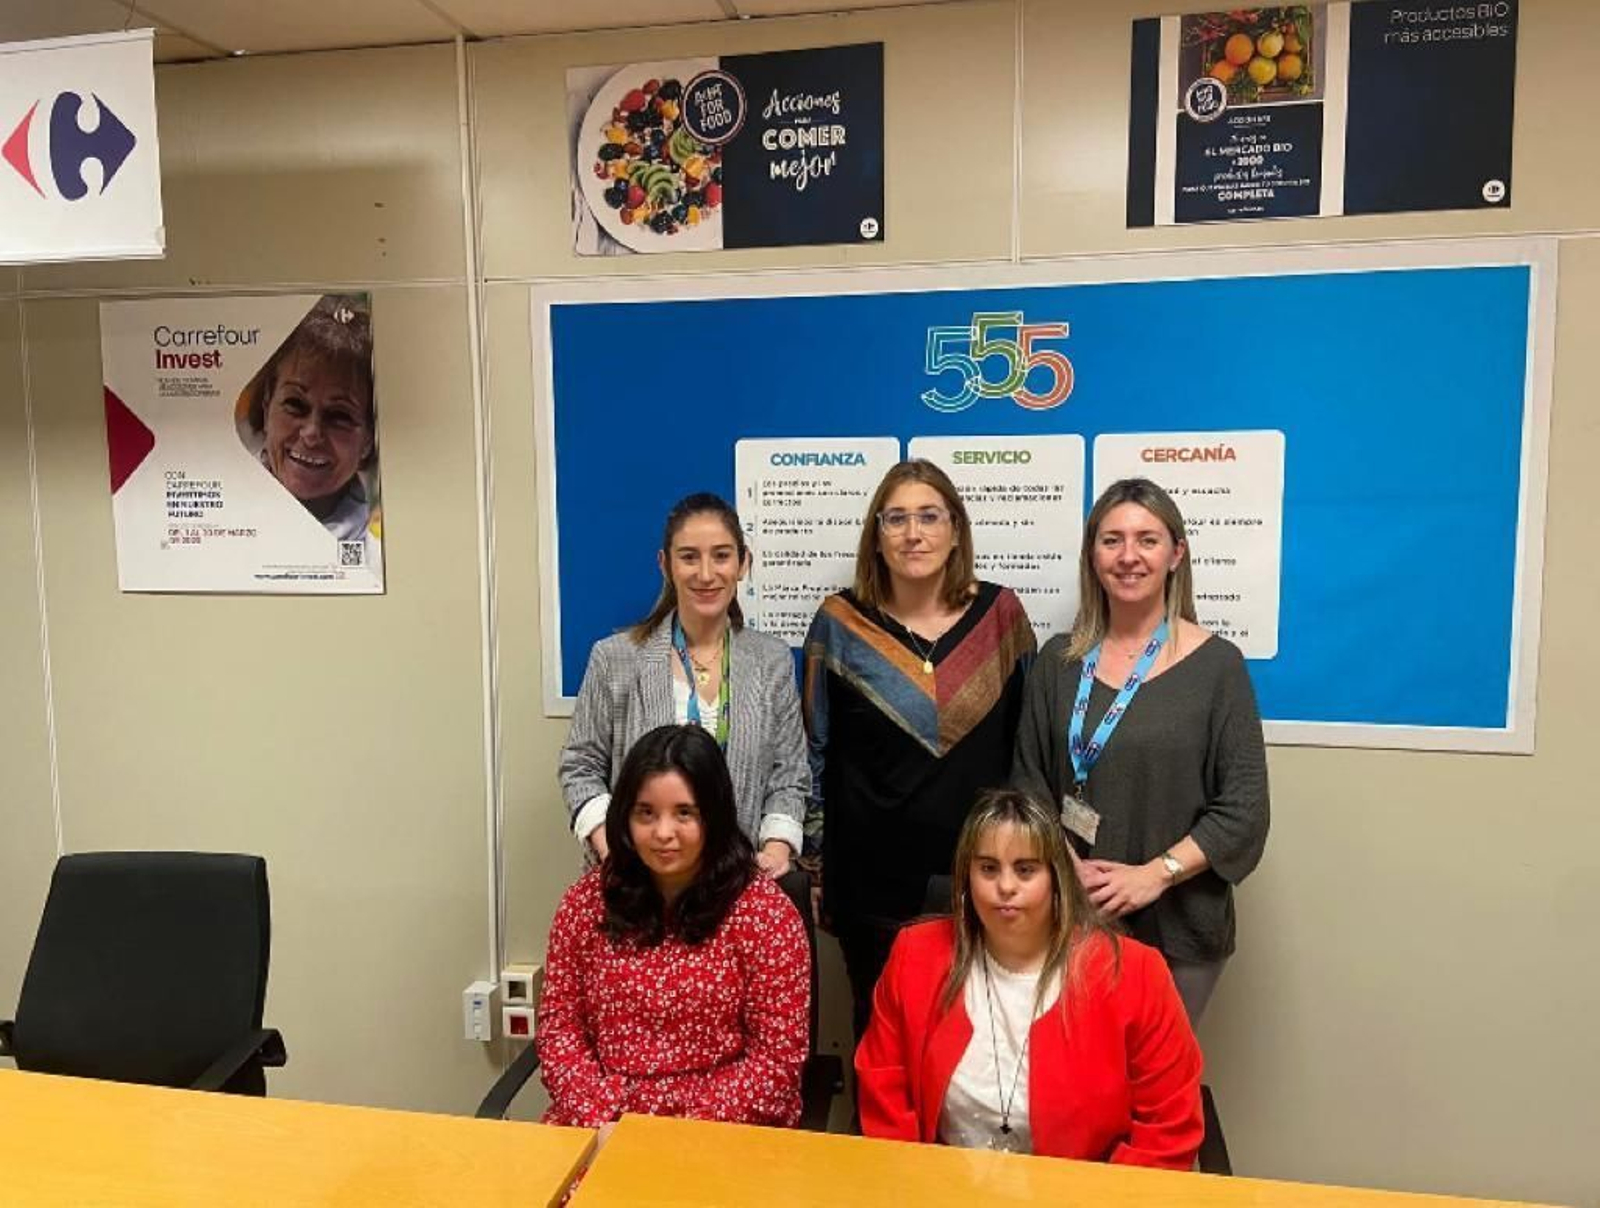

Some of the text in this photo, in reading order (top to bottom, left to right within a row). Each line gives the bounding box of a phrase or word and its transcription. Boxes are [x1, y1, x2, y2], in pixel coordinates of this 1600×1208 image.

[762, 125, 847, 151] COMER
[1219, 144, 1270, 157] MERCADO
[1217, 188, 1275, 202] COMPLETA
[154, 325, 260, 347] Carrefour
[770, 452, 866, 466] CONFIANZA
[952, 450, 1032, 465] SERVICIO
[1141, 443, 1237, 463] CERCANÍA
